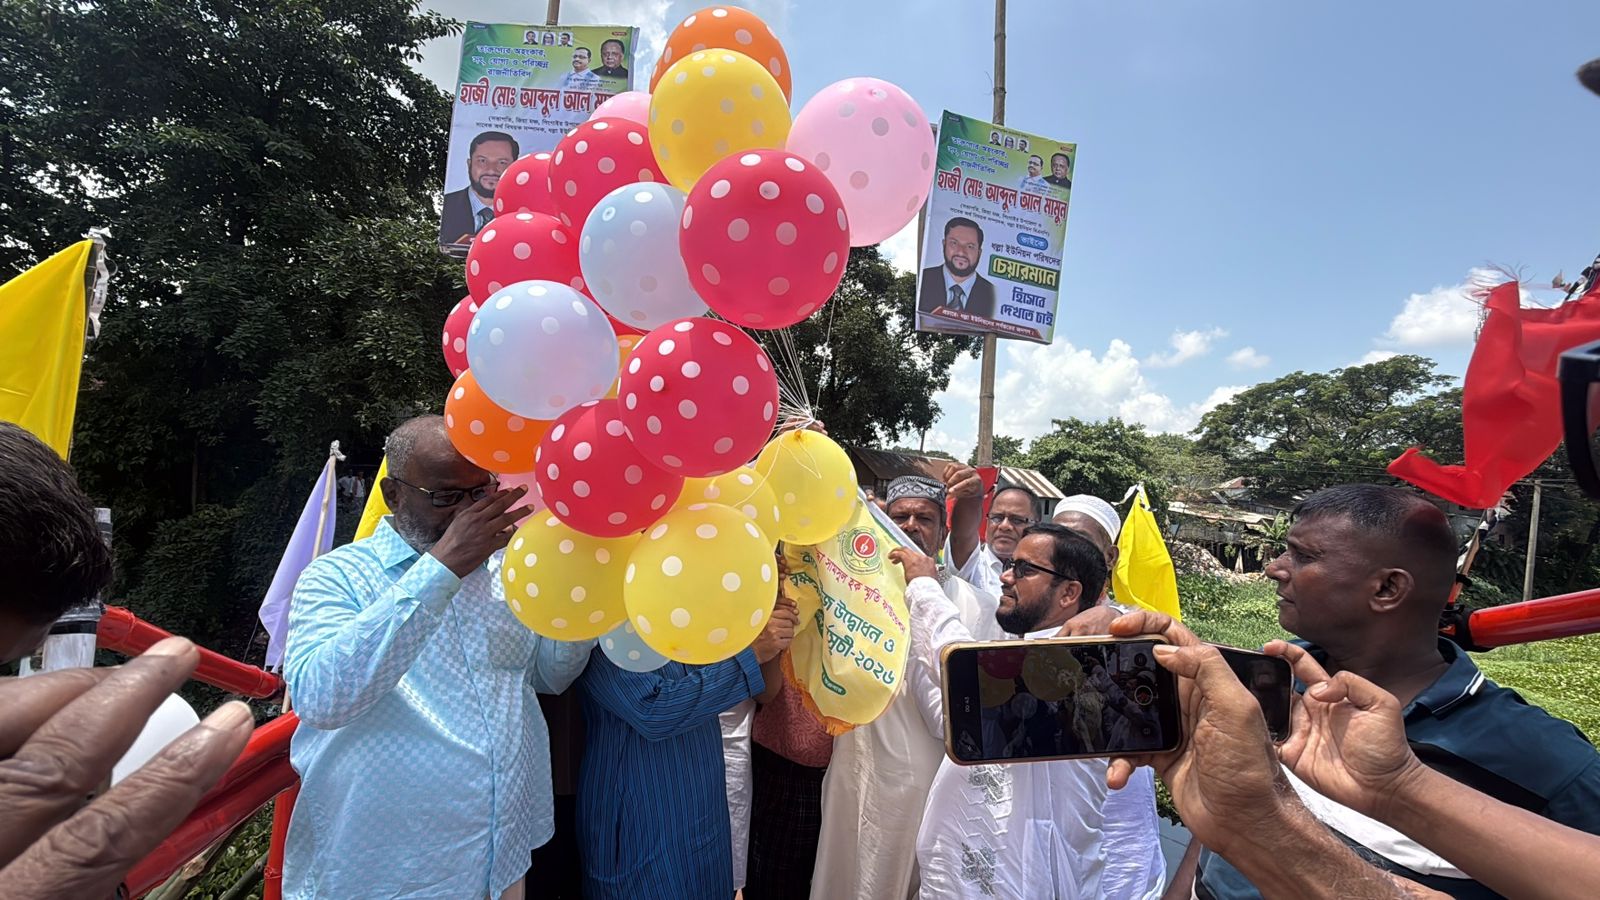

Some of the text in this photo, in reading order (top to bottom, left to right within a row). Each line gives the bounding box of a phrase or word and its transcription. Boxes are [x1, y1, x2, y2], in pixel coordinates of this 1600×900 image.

[459, 76, 489, 105] হাজী
[492, 86, 516, 107] মোঃ
[520, 88, 560, 117] আব্দুল
[563, 90, 590, 111] আল
[938, 166, 962, 191] হাজী
[963, 178, 983, 197] মোঃ
[986, 183, 1018, 212] আব্দুল
[1020, 191, 1042, 213] আল
[1044, 198, 1067, 223] মামুন
[1021, 235, 1045, 248] ভাইকে
[1006, 244, 1031, 259] ইউনিয়ন
[1033, 251, 1061, 266] পরিষদের
[993, 257, 1057, 287] চেয়ারম্যান
[1012, 286, 1046, 308] হিসেবে
[1000, 304, 1053, 326] দেখতে চাই
[848, 577, 863, 591] হক
[834, 600, 883, 643] উদ্বোধন
[884, 639, 894, 652] ও
[826, 624, 894, 684] সূচী-২০২৬
